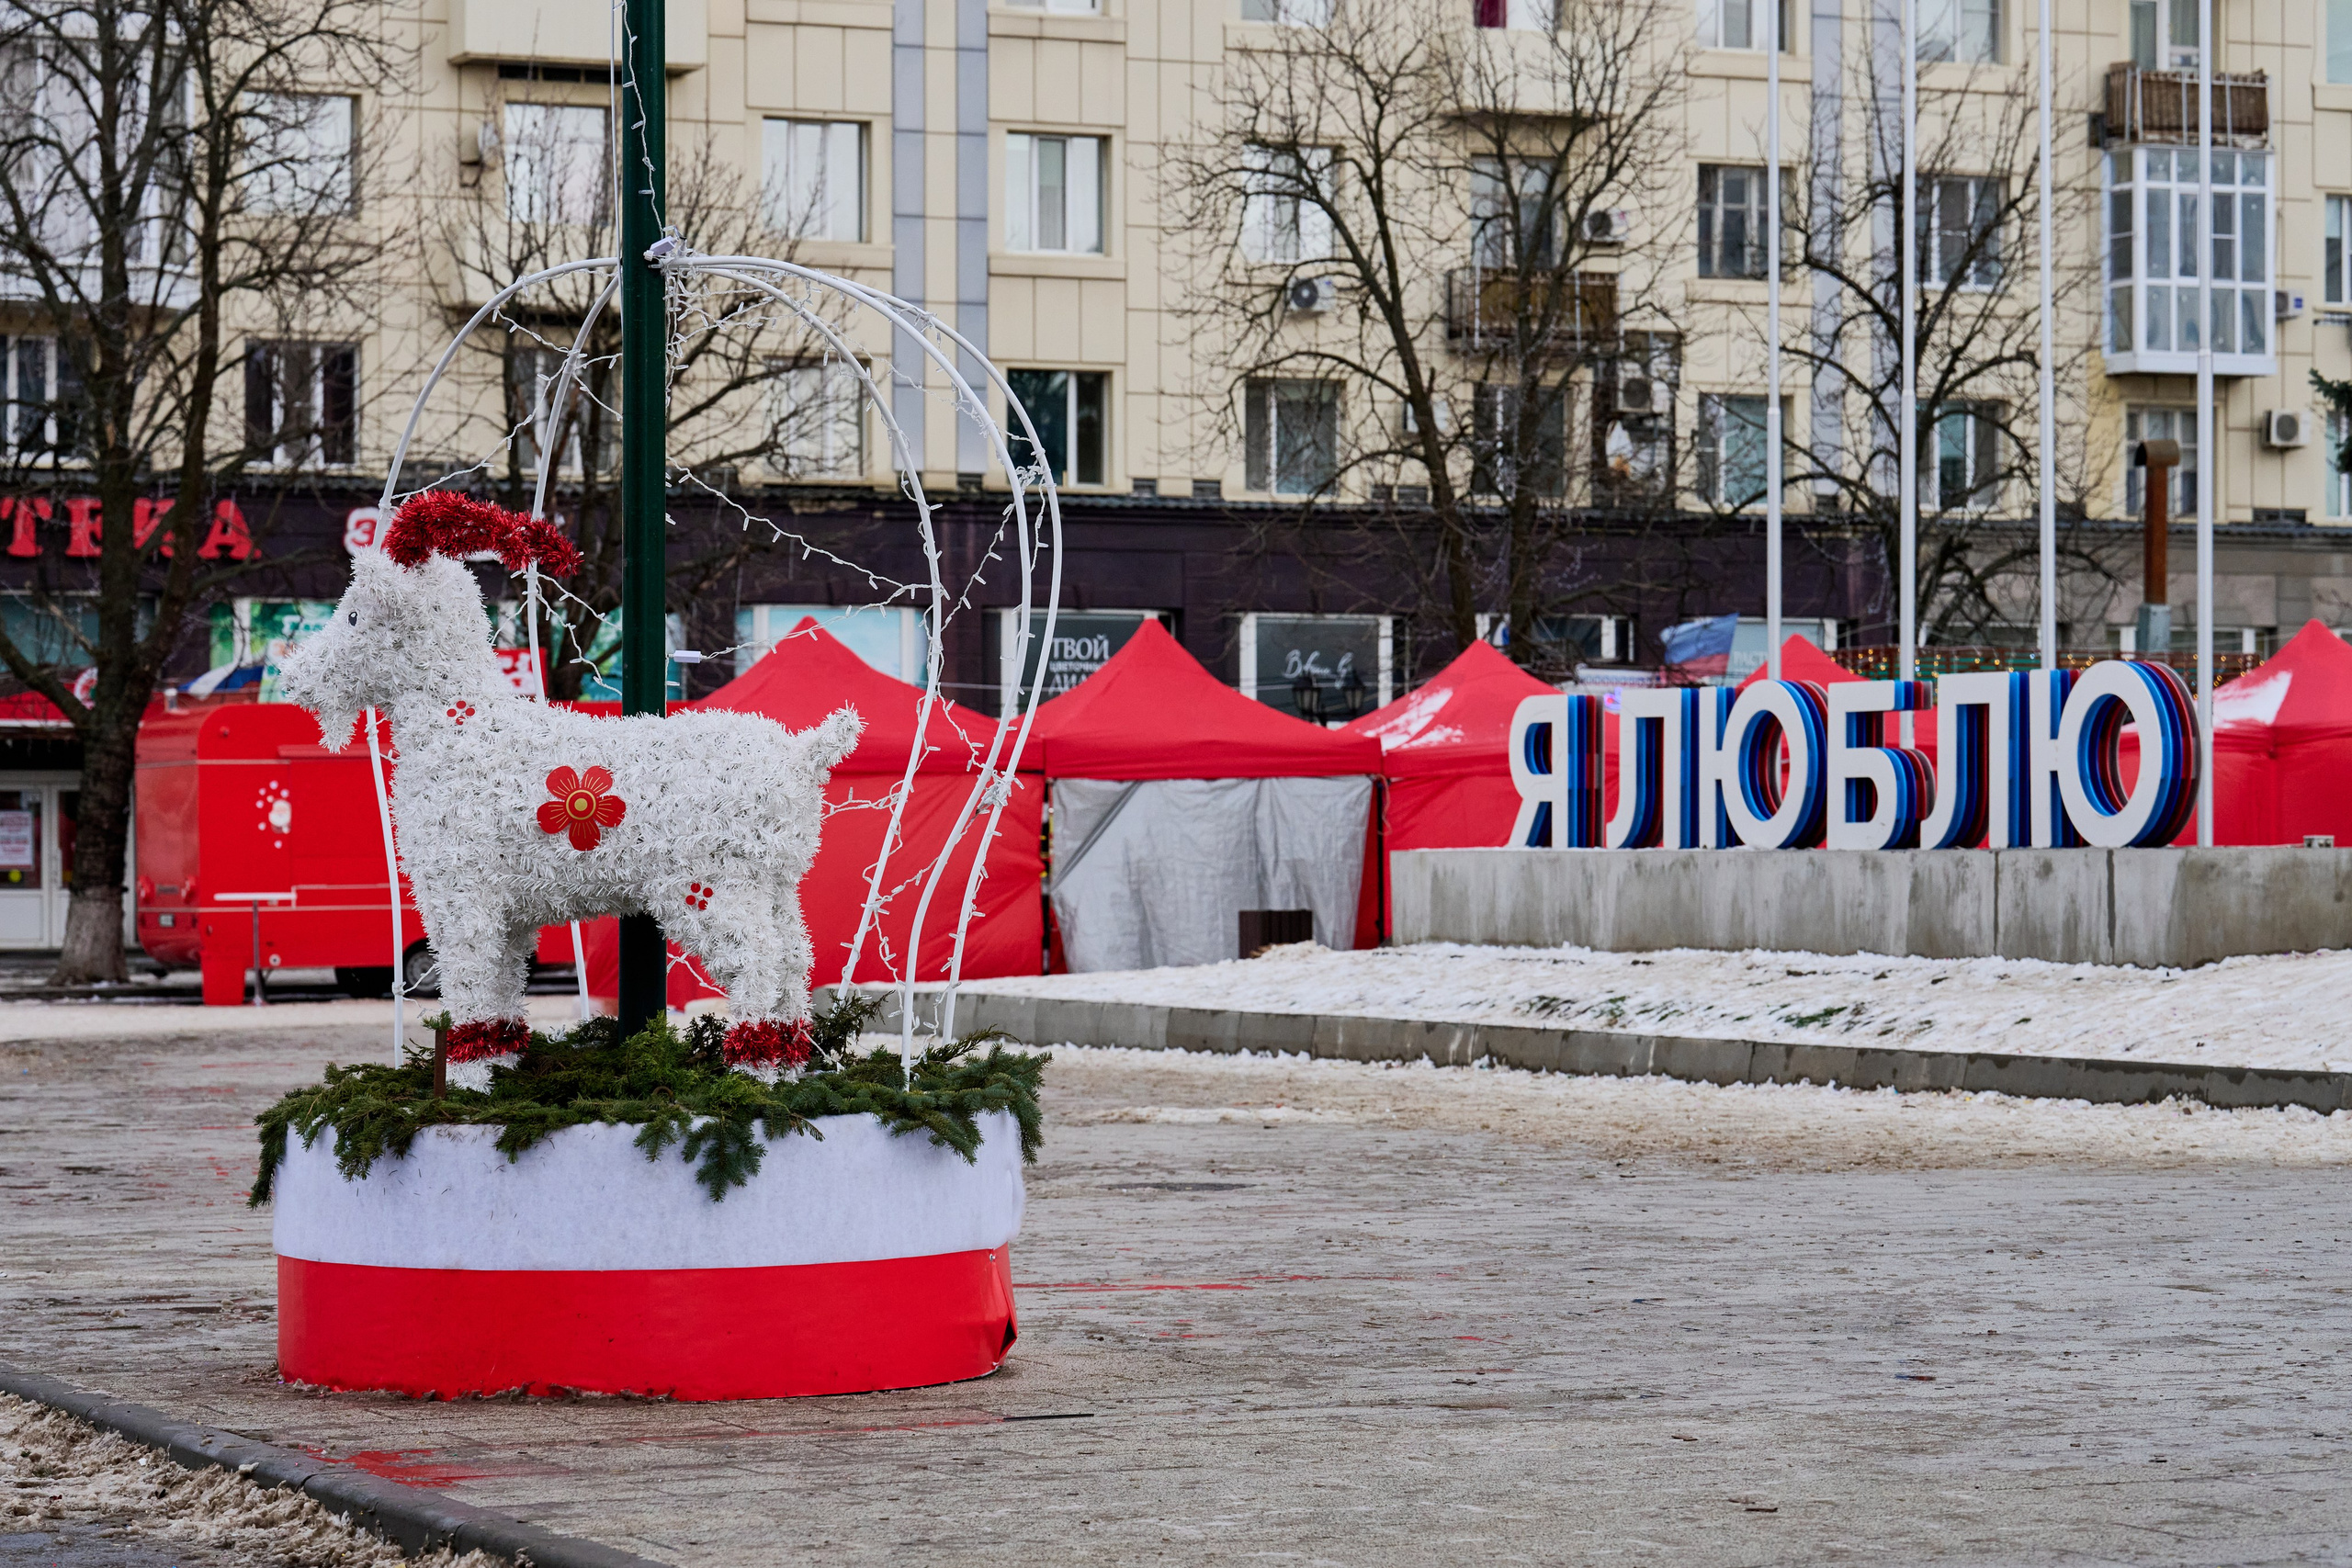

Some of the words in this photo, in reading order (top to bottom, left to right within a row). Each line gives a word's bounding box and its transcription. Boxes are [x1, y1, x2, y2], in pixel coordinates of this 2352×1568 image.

[1052, 634, 1110, 660] ТВОЙ
[1508, 694, 1582, 849] Я
[1606, 660, 2191, 851] ЛЮБЛЮ
